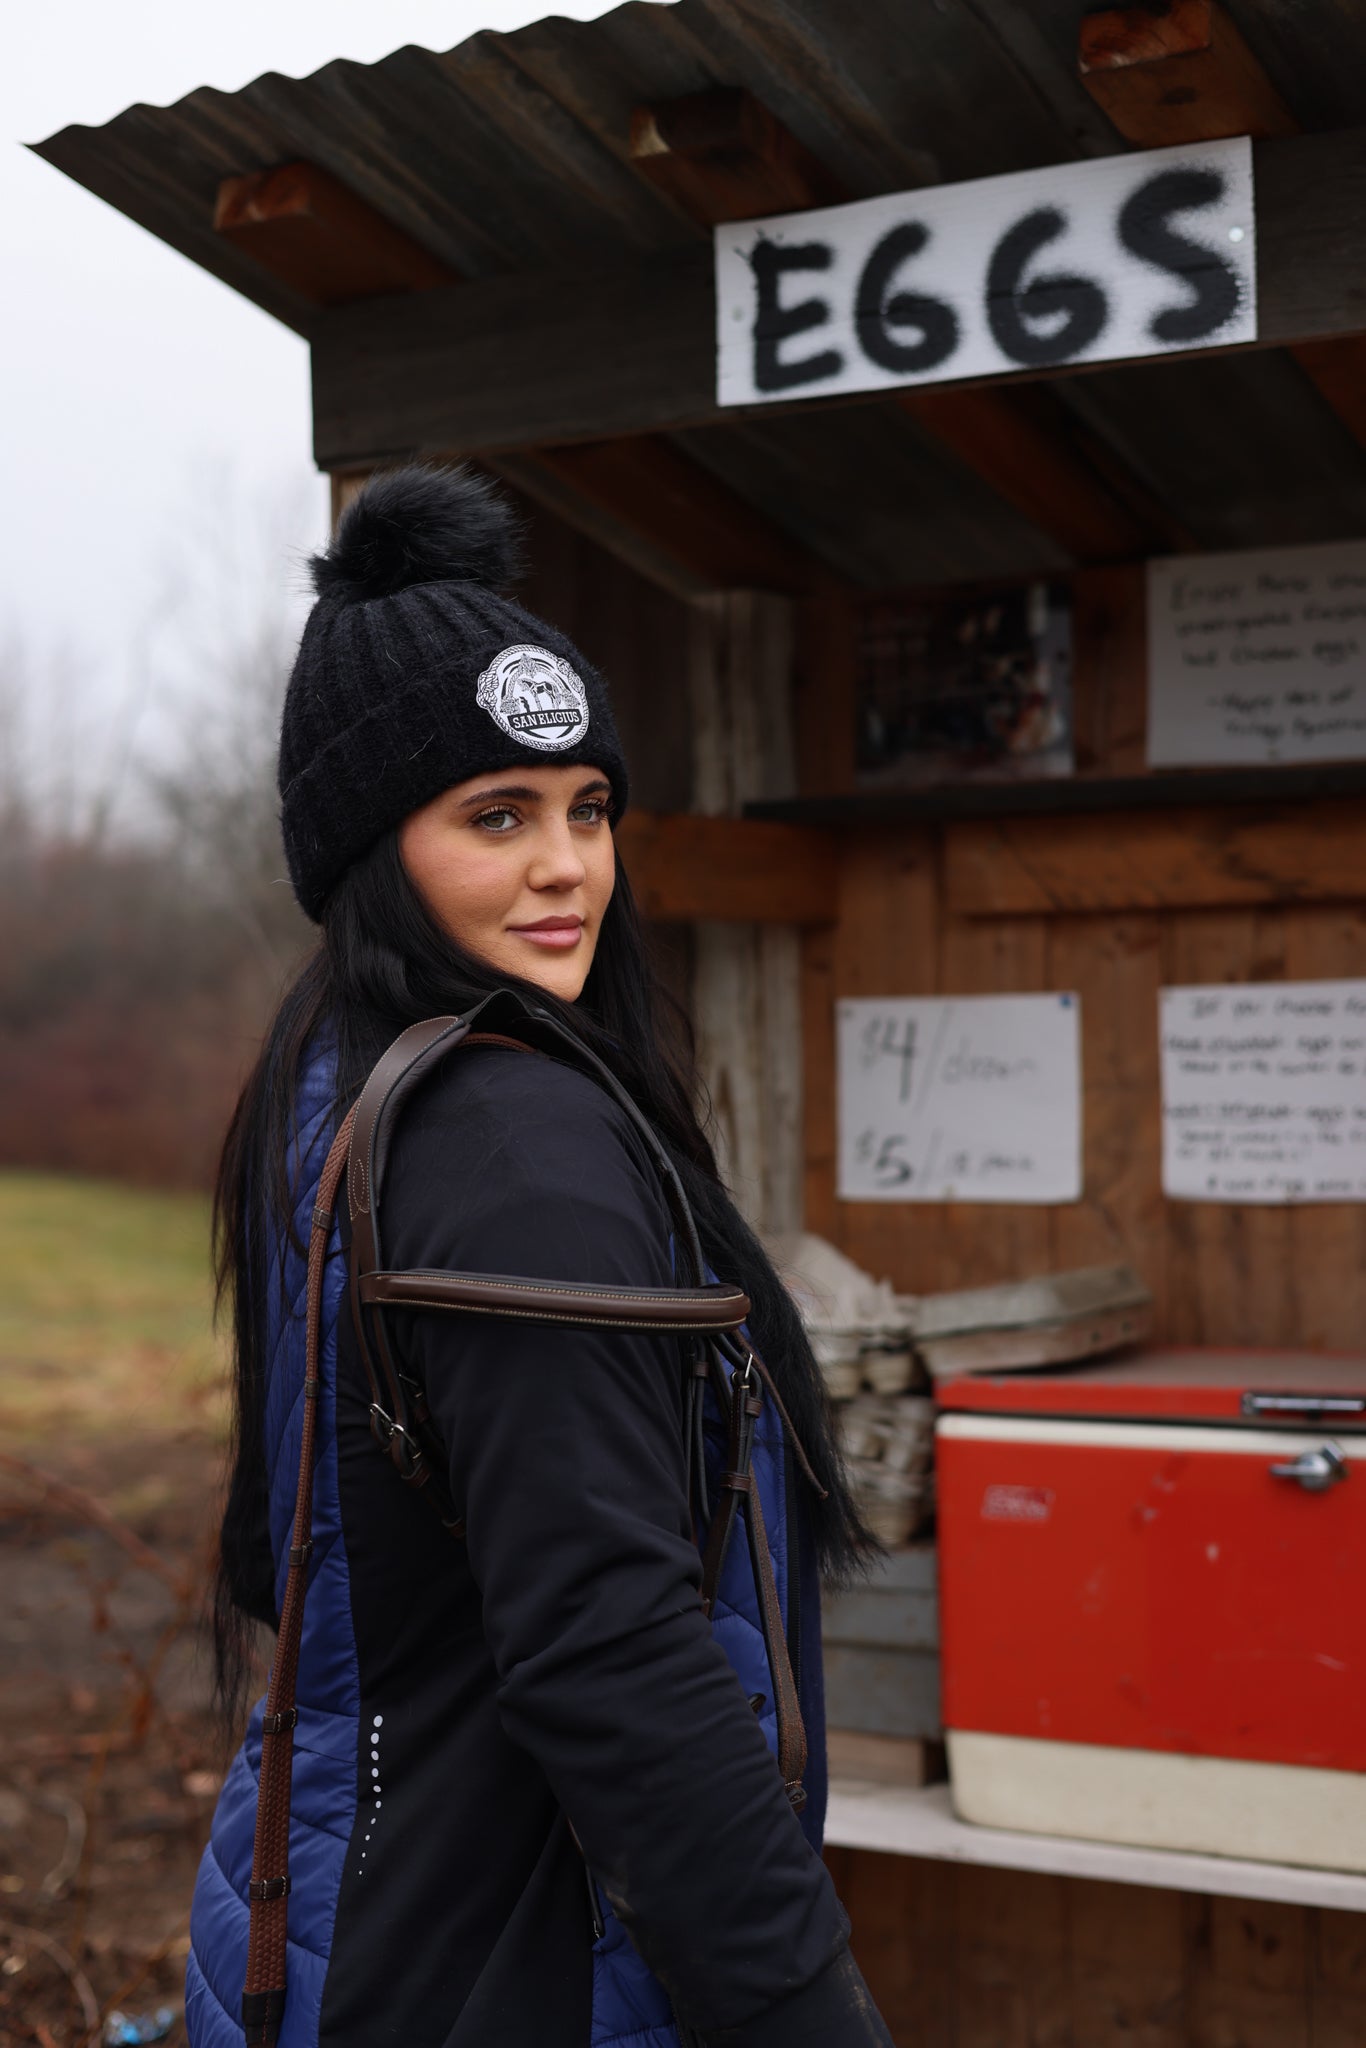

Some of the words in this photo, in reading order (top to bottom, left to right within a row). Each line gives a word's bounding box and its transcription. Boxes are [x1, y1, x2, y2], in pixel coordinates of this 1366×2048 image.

[750, 166, 1240, 394] EGGS
[512, 713, 538, 729] SAN
[539, 711, 580, 725] ELIGIUS
